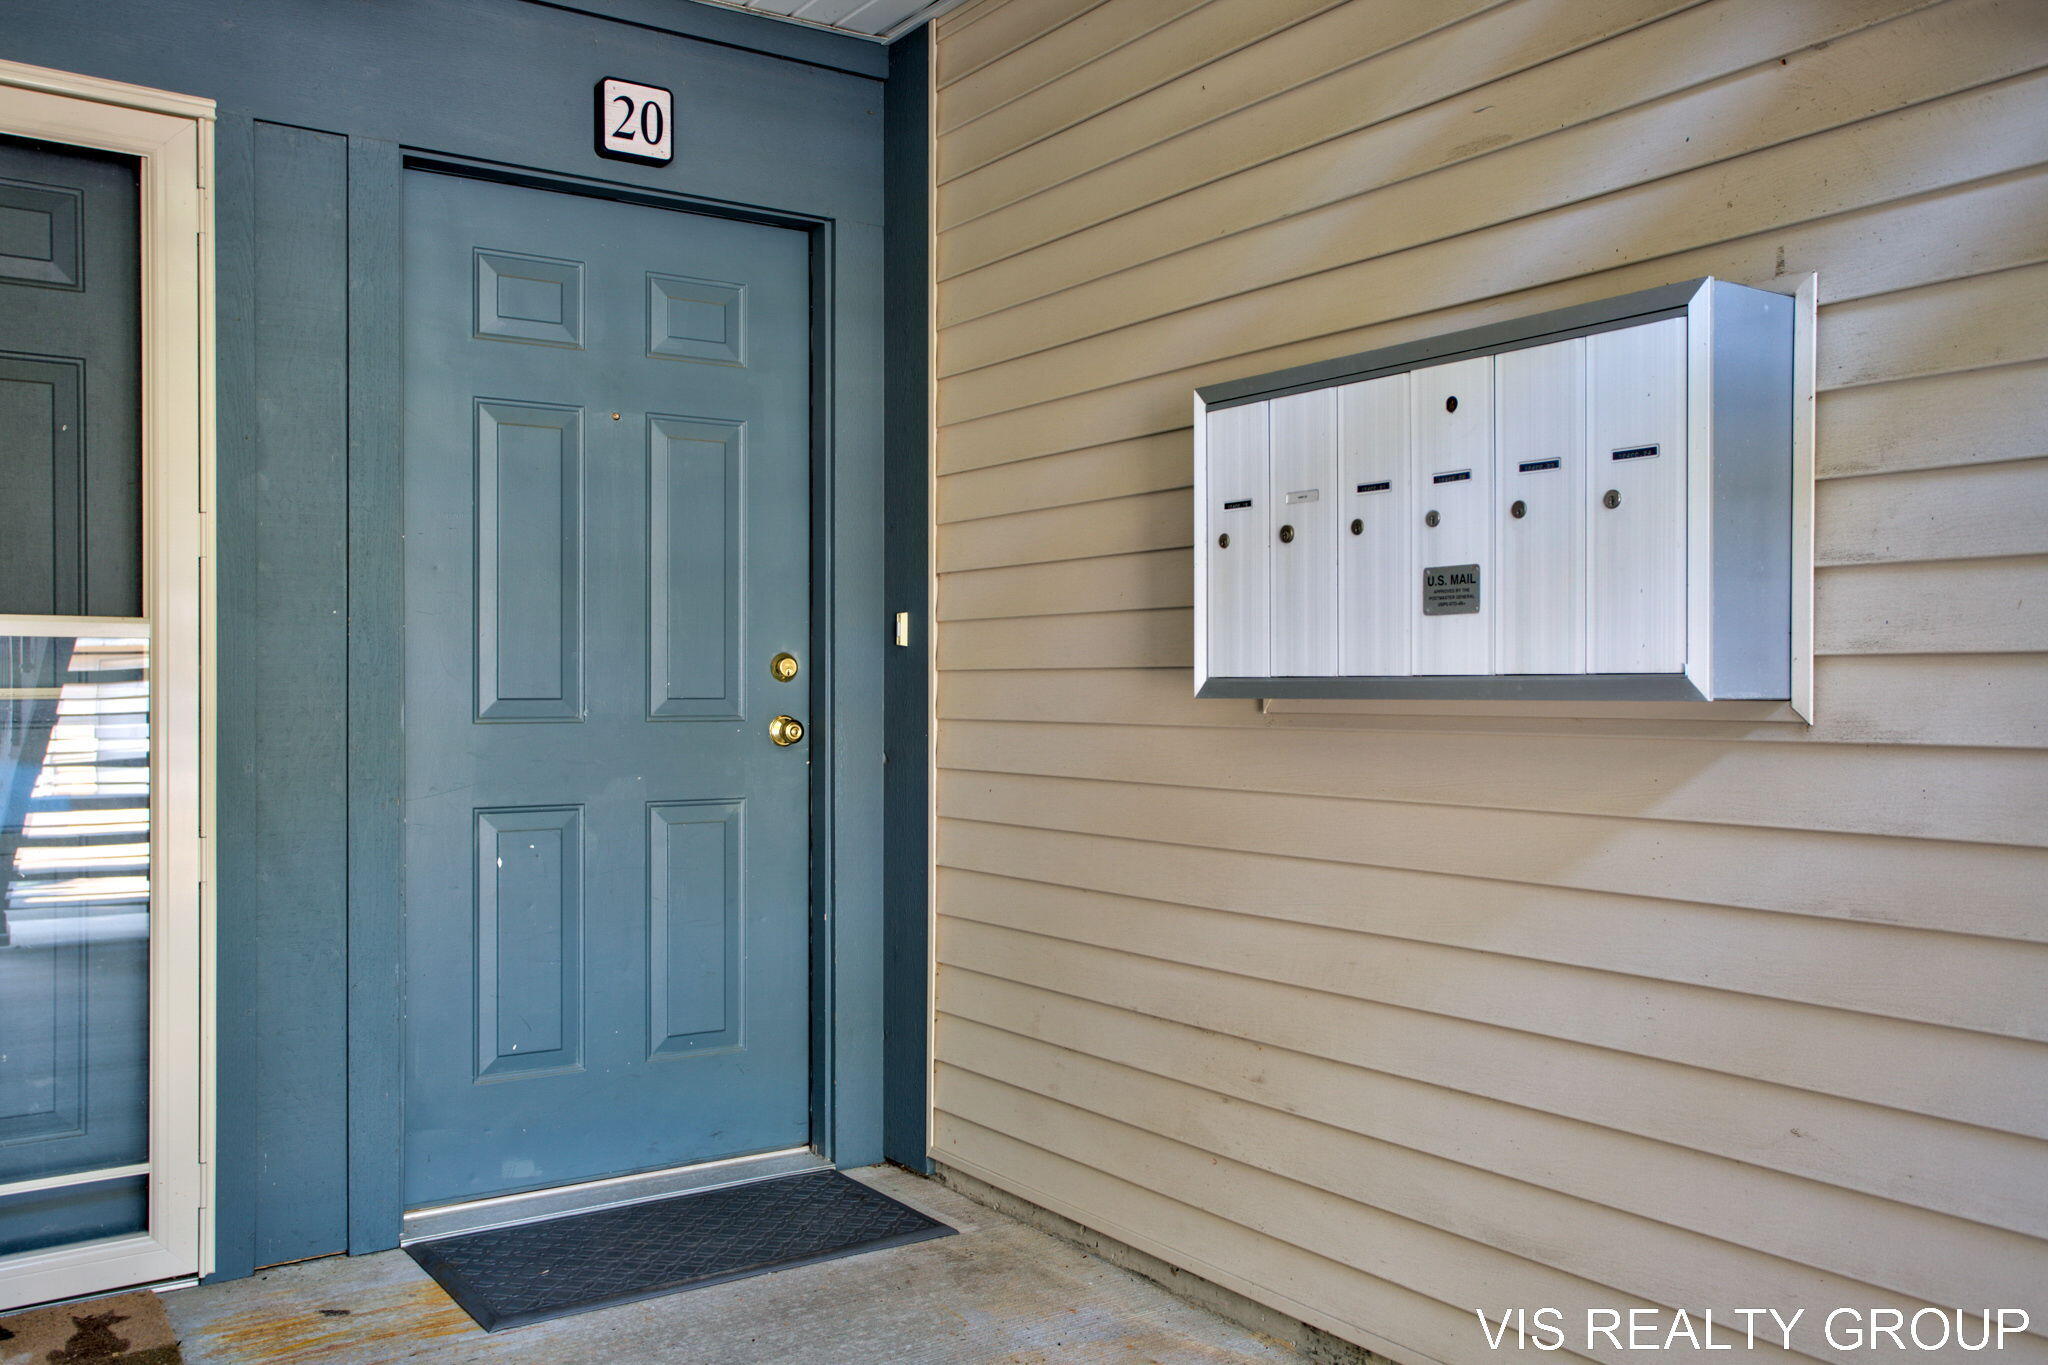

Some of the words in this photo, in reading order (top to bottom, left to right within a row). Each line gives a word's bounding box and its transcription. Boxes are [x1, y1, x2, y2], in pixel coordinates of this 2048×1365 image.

[612, 95, 664, 145] 20
[1427, 575, 1448, 587] U.S.
[1450, 573, 1477, 585] MAIL
